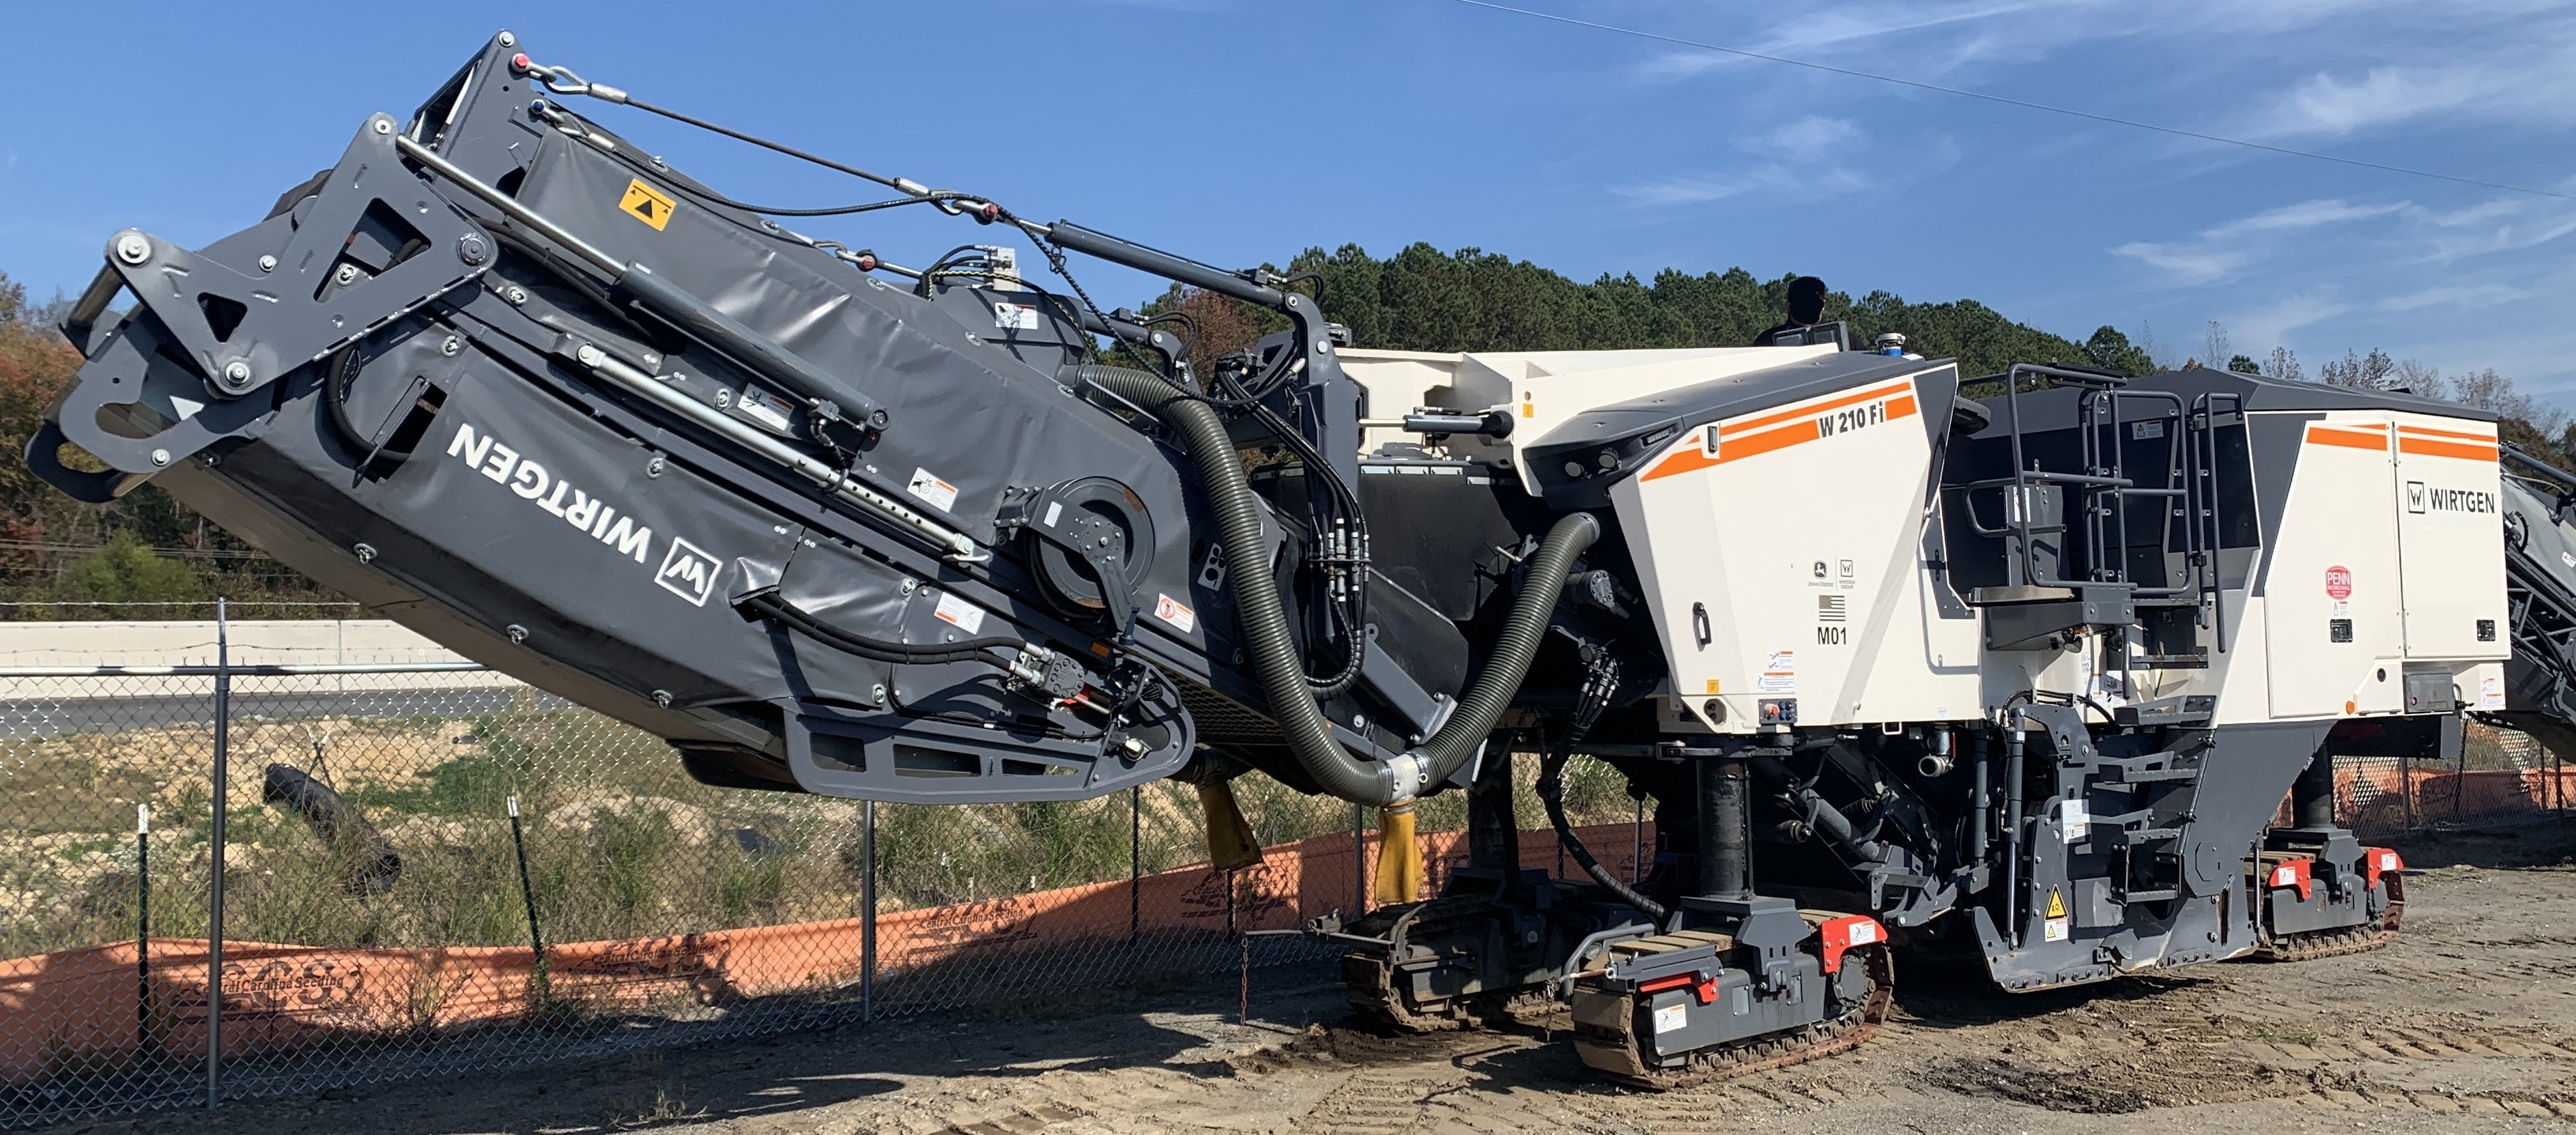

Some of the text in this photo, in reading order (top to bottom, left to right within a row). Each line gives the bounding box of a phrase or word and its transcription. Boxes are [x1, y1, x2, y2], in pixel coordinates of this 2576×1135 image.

[1819, 401, 1884, 438] W 210 Fi
[446, 422, 652, 564] WIRTGEN
[2429, 488, 2495, 513] WIRTGEN
[2328, 571, 2351, 586] PENN
[1817, 626, 1846, 645] M01
[952, 913, 989, 926] Carolina
[989, 908, 1025, 921] Seeding
[629, 947, 672, 960] Carolina
[195, 975, 344, 995] Cetral Carolina Seeding
